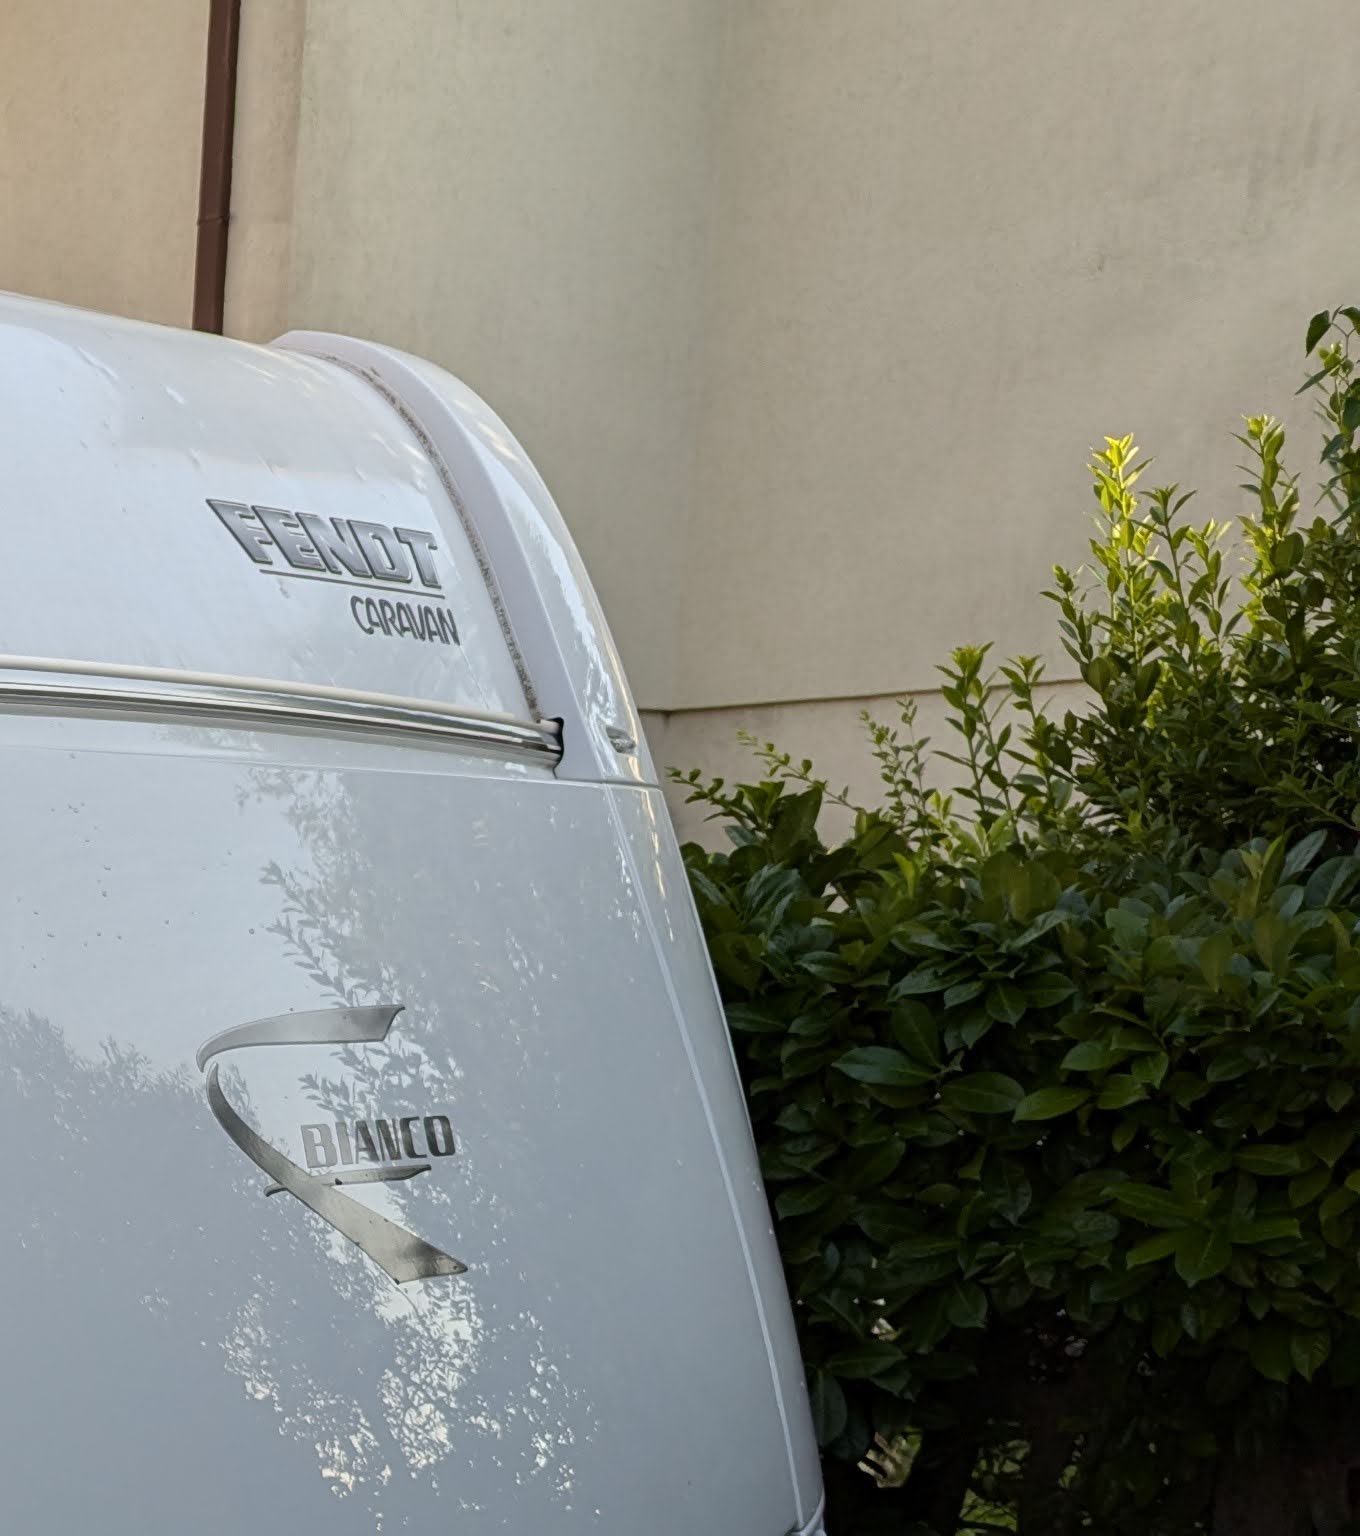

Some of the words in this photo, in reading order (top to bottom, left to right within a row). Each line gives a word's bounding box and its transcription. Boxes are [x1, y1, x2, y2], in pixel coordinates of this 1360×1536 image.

[205, 498, 442, 590] FENDT
[349, 595, 461, 647] CARAVAN
[300, 1114, 457, 1169] BIANCO
